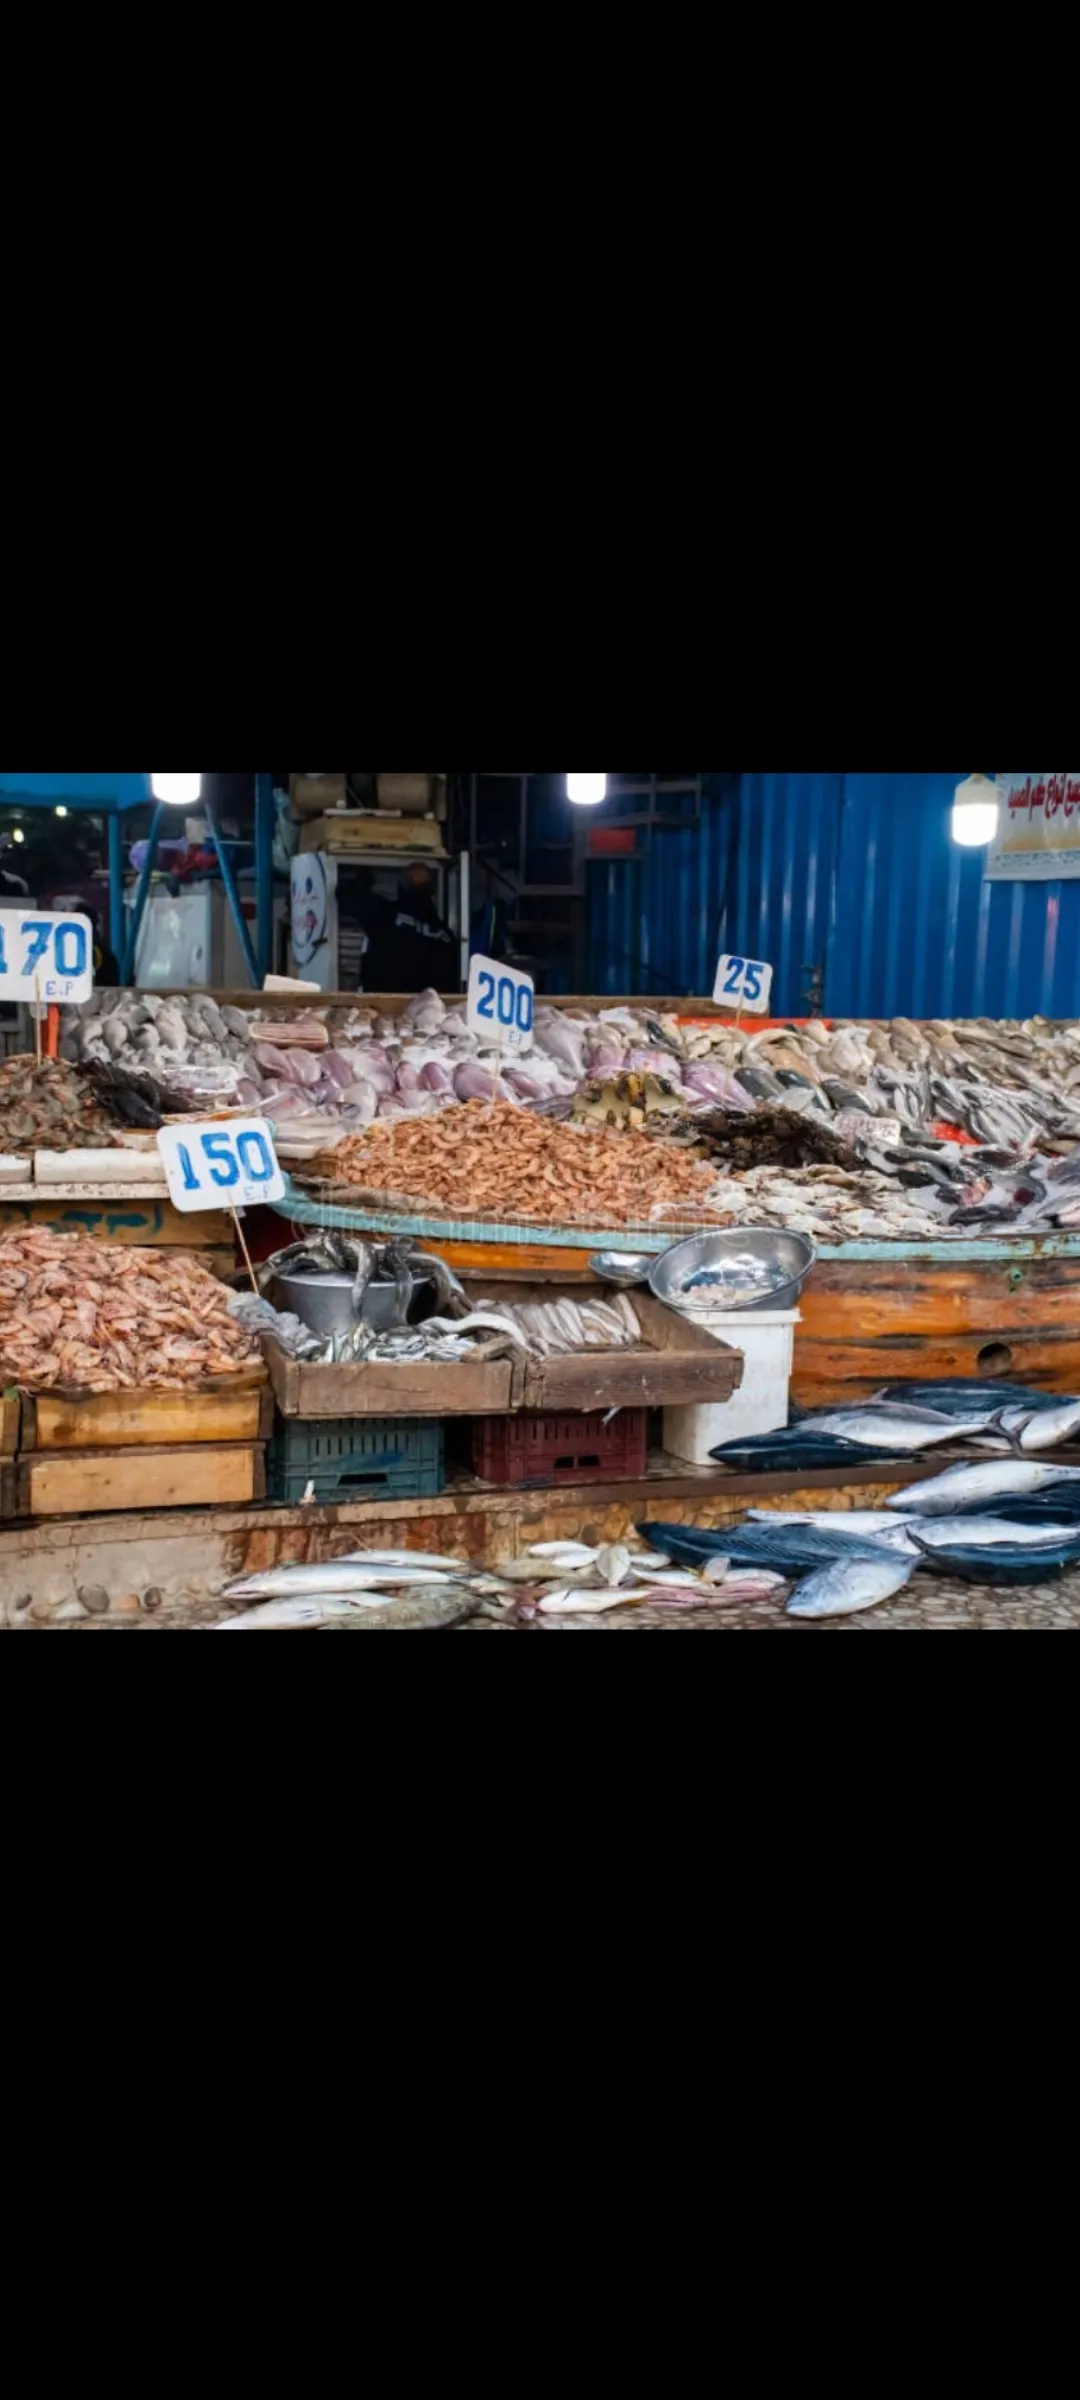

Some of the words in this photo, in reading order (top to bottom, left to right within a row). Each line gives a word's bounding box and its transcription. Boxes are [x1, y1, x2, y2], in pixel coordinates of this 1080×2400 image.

[396, 912, 451, 943] FILA
[476, 970, 534, 1032] 200
[722, 957, 765, 1001] 25
[176, 1131, 274, 1190] 150
